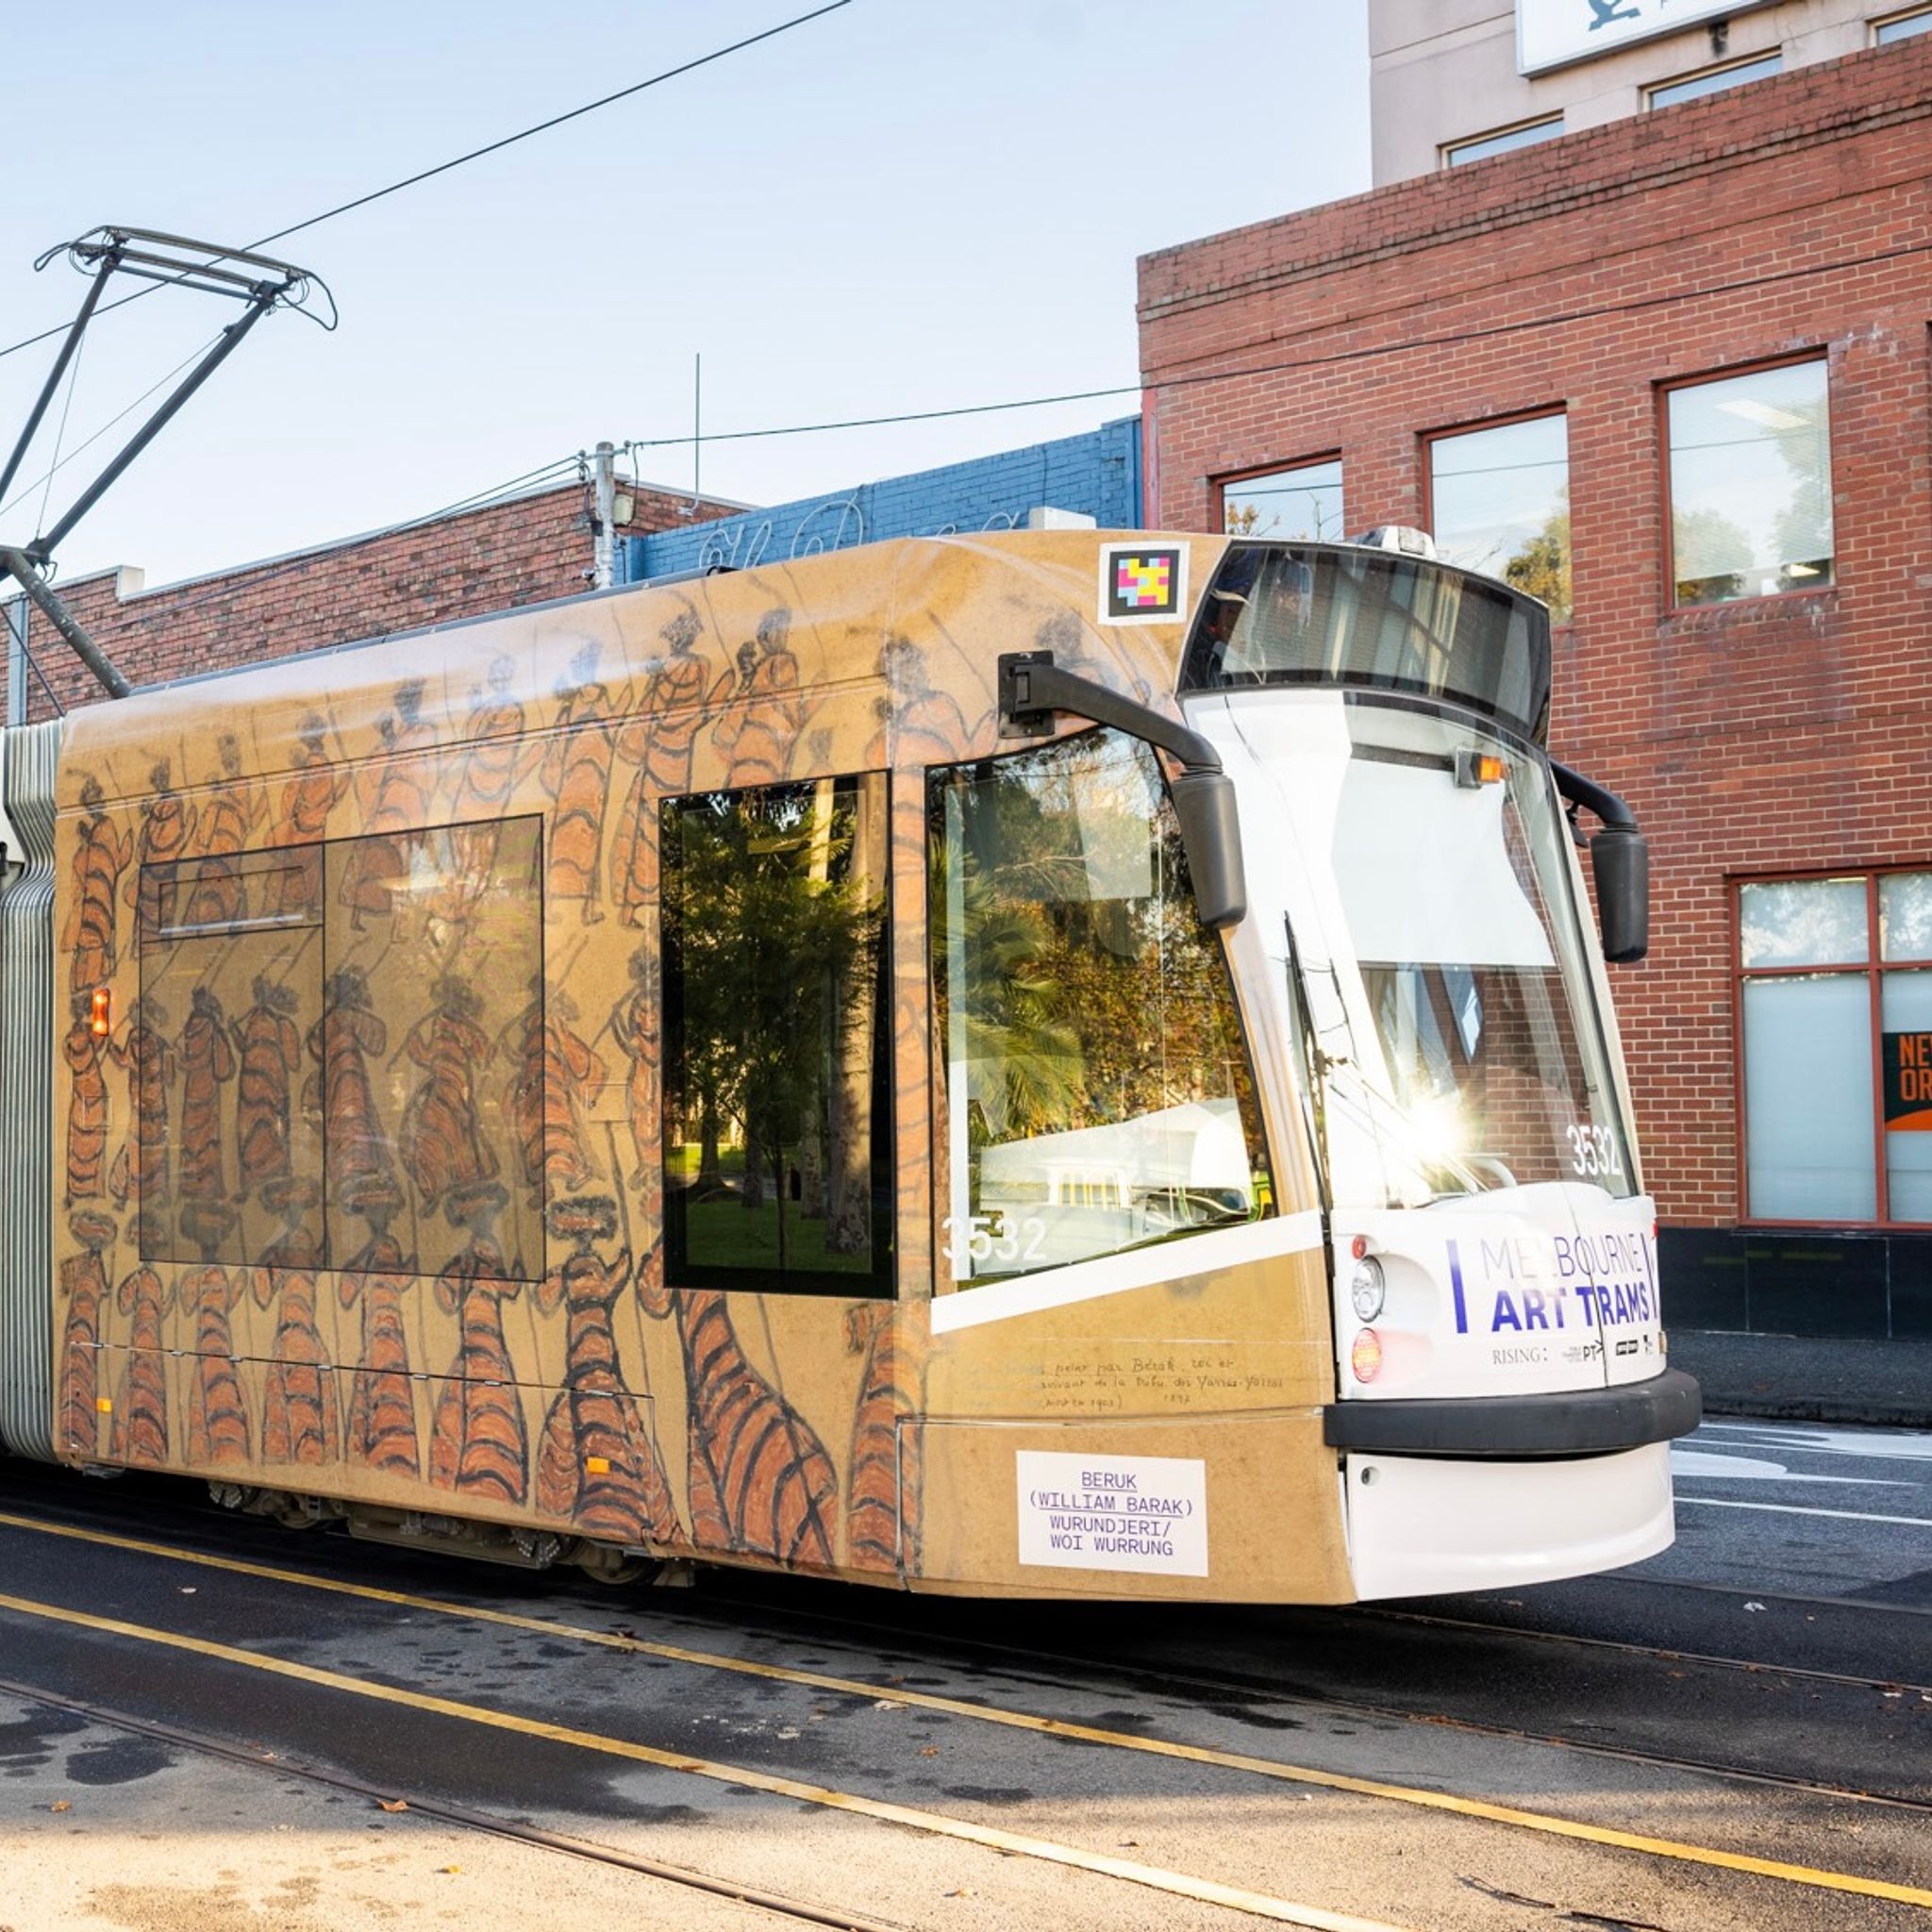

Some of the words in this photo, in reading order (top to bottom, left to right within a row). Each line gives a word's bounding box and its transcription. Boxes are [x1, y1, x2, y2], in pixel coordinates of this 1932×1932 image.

[1898, 1034, 1932, 1068] NE
[1566, 1124, 1621, 1176] 3532
[941, 1216, 1047, 1261] 3532
[1491, 1287, 1567, 1333] ART
[1575, 1280, 1651, 1327] TRAMS
[1081, 1471, 1138, 1490] BERUK
[1029, 1490, 1116, 1511] (WILLIAM
[1126, 1496, 1193, 1517] BARAK)
[1049, 1515, 1172, 1538] WURUNDJERI/
[1050, 1534, 1084, 1551] WOI
[1093, 1537, 1174, 1557] WURRUNG
